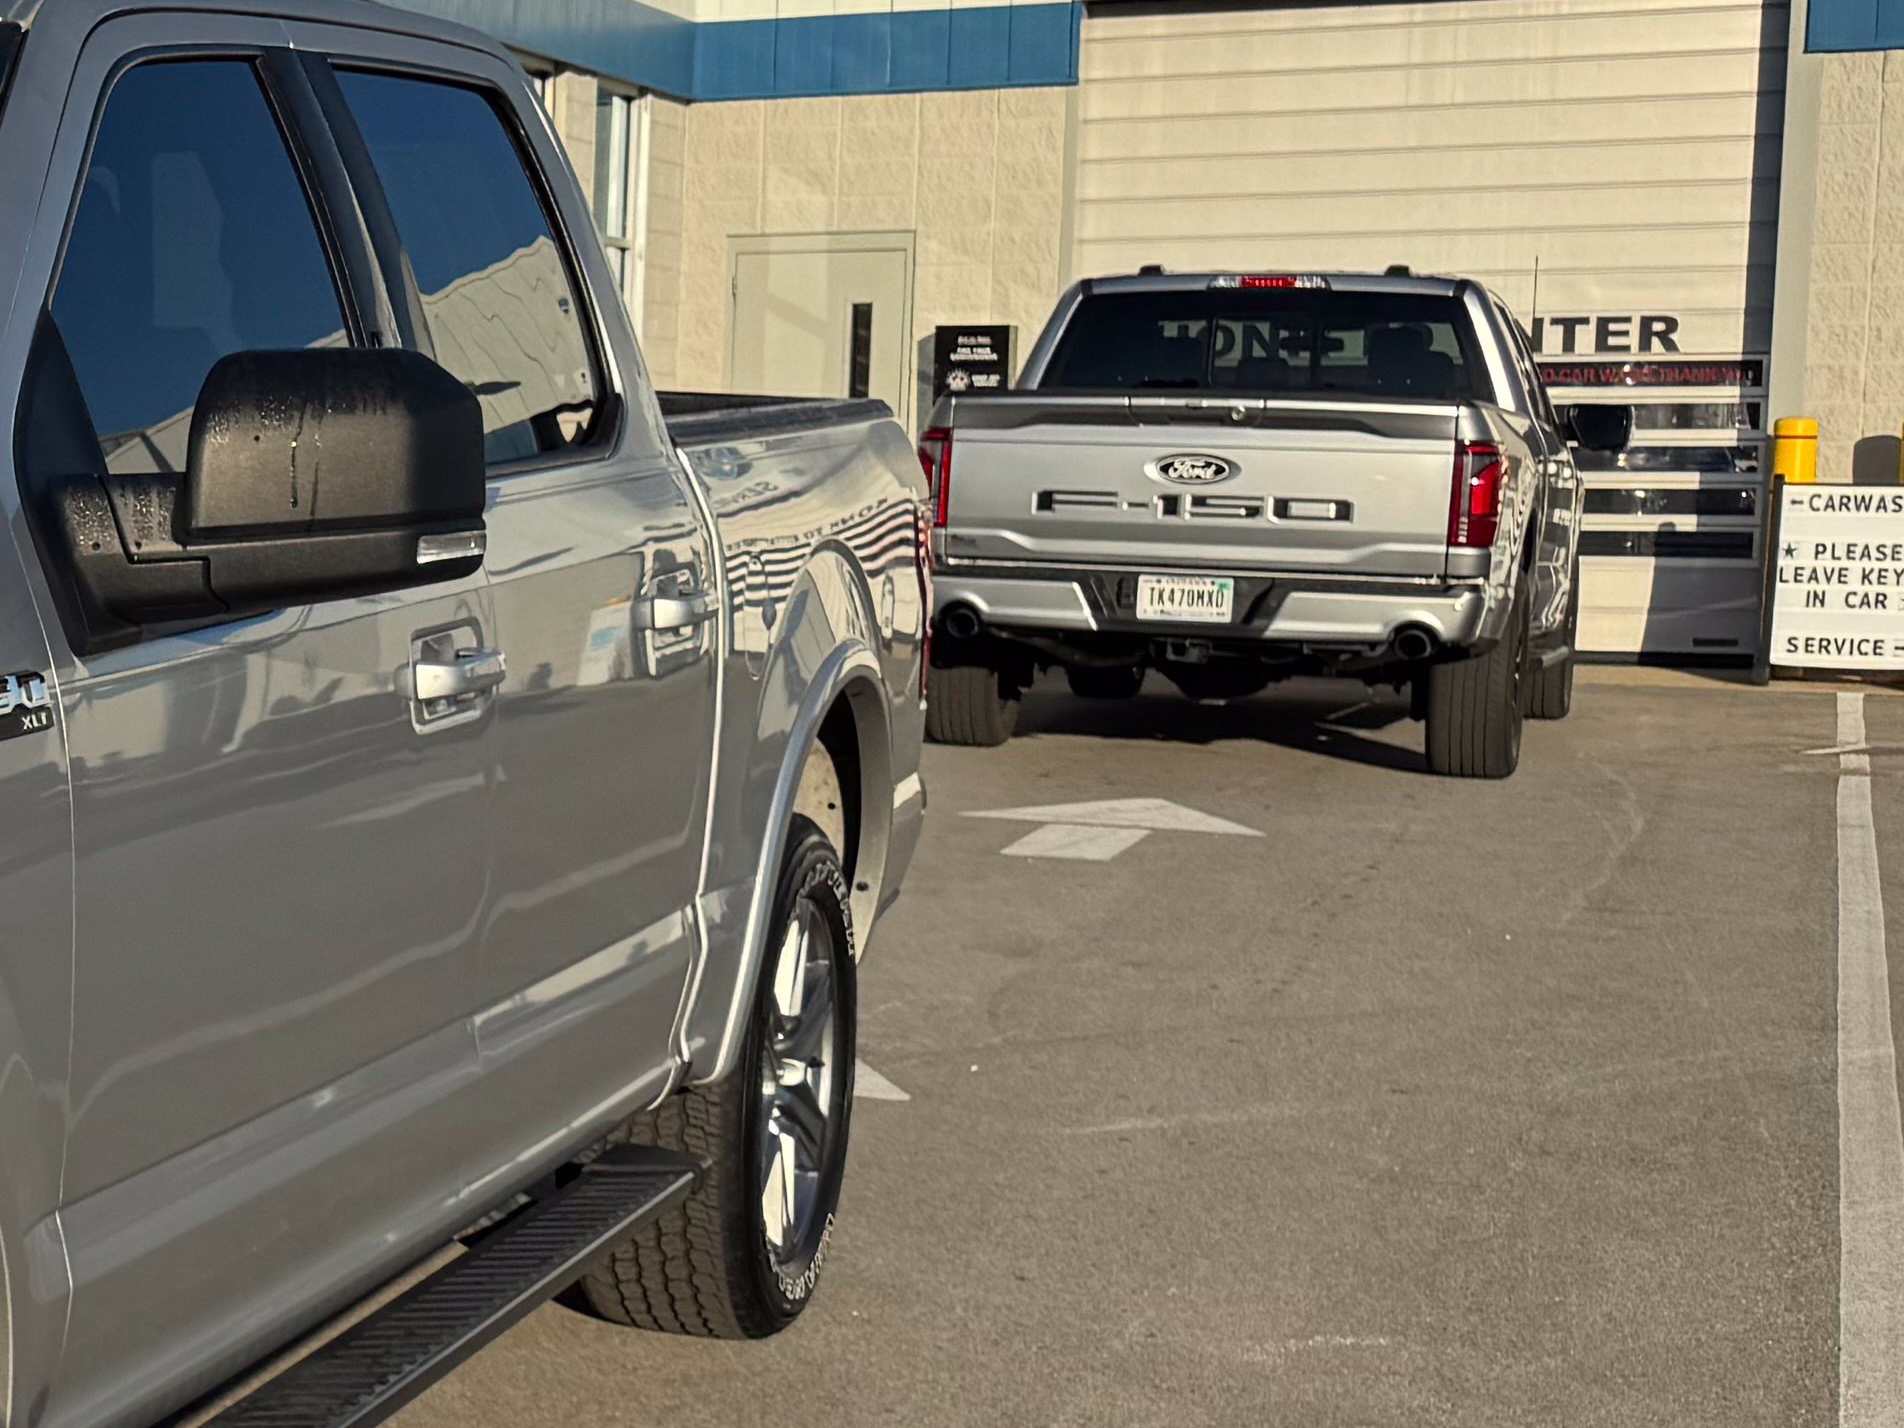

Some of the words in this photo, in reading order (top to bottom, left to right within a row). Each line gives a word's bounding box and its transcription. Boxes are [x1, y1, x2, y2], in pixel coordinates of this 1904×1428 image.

[1168, 457, 1216, 480] Ford
[1031, 490, 1356, 523] F-150
[1814, 542, 1903, 562] PLEASE
[1778, 566, 1849, 584] LEAVE
[1805, 589, 1826, 608] IN
[1844, 591, 1888, 609] CAR
[1785, 636, 1885, 656] SERVICE
[20, 711, 49, 731] XLT
